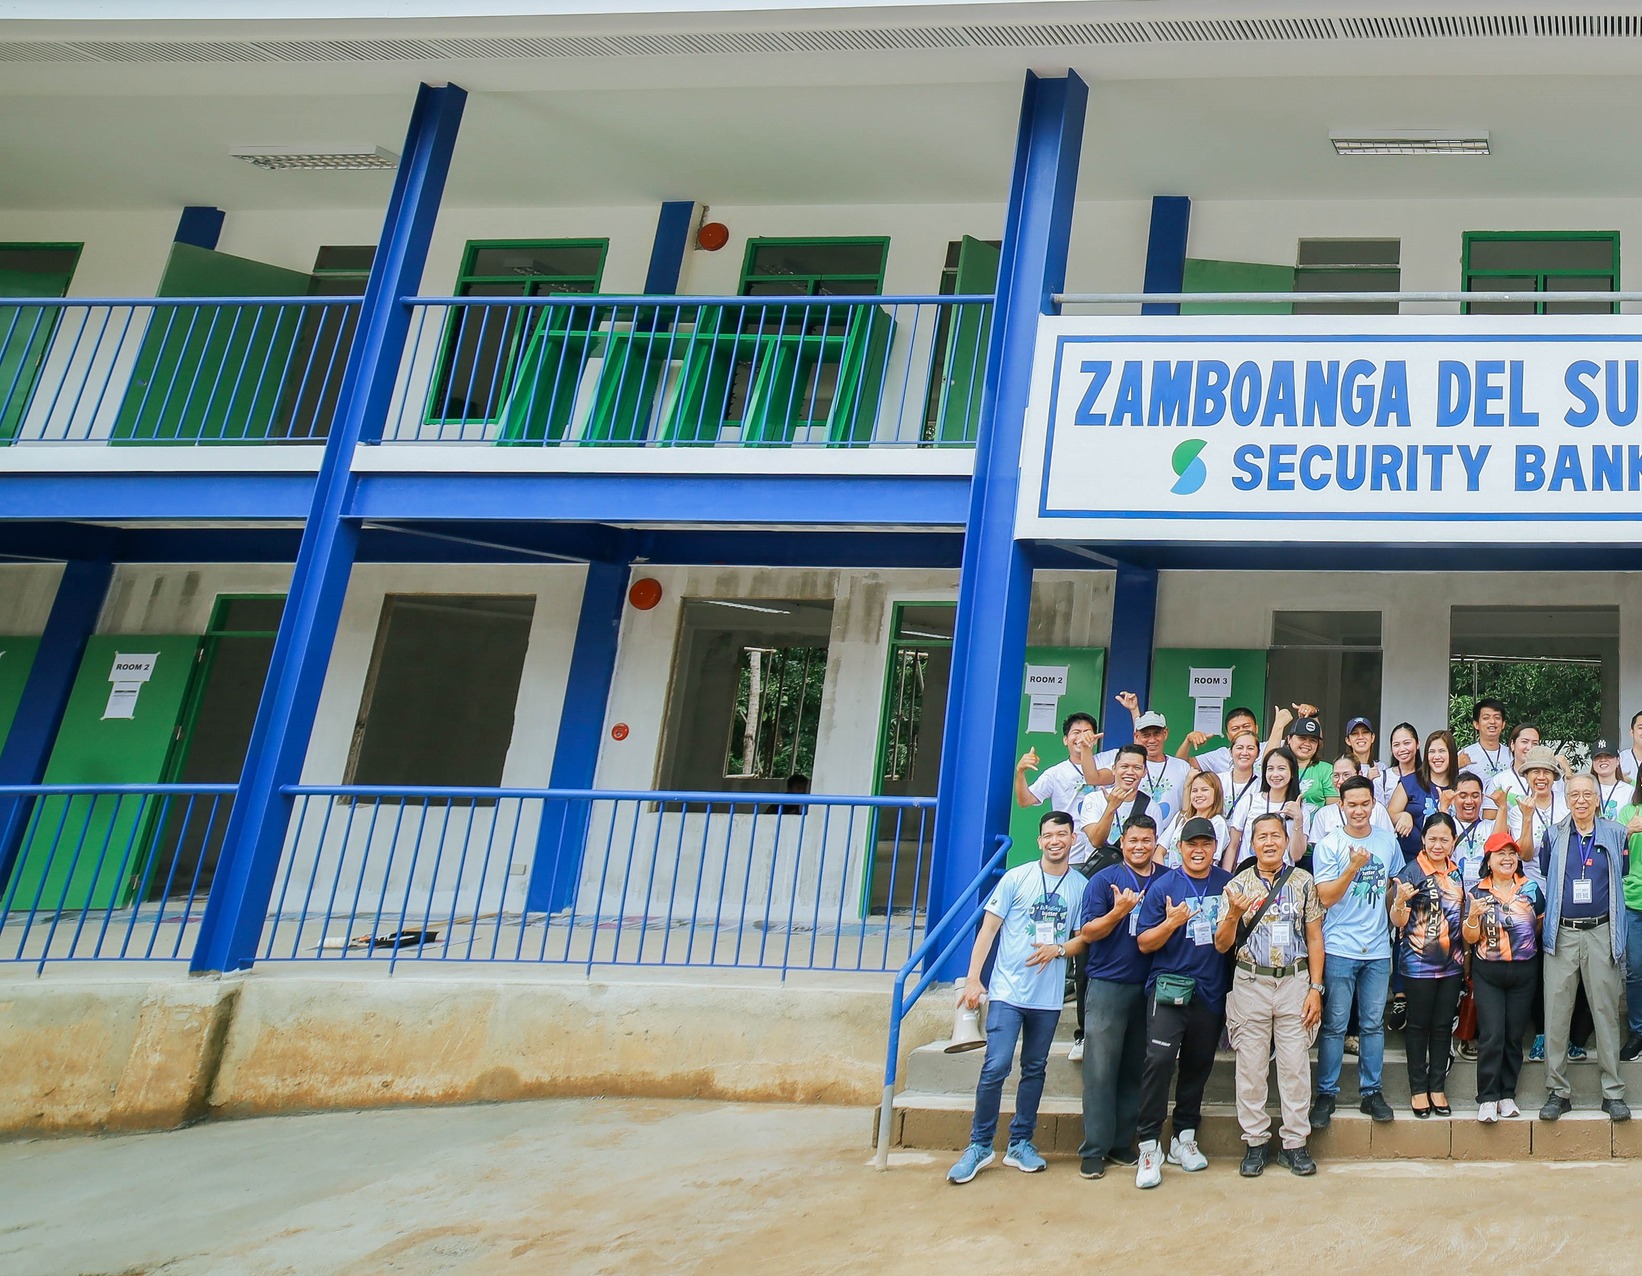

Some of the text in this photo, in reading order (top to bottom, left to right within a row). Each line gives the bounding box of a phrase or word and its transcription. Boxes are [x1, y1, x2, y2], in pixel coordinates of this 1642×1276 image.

[1074, 358, 1411, 427] ZAMBOANGA
[1436, 358, 1540, 427] DEL
[1231, 443, 1492, 492] SECURITY
[115, 663, 150, 671] ROOM 2
[1029, 675, 1063, 684] ROOM 2
[1194, 677, 1228, 685] ROOM 3
[1426, 878, 1439, 937] ZSNHS
